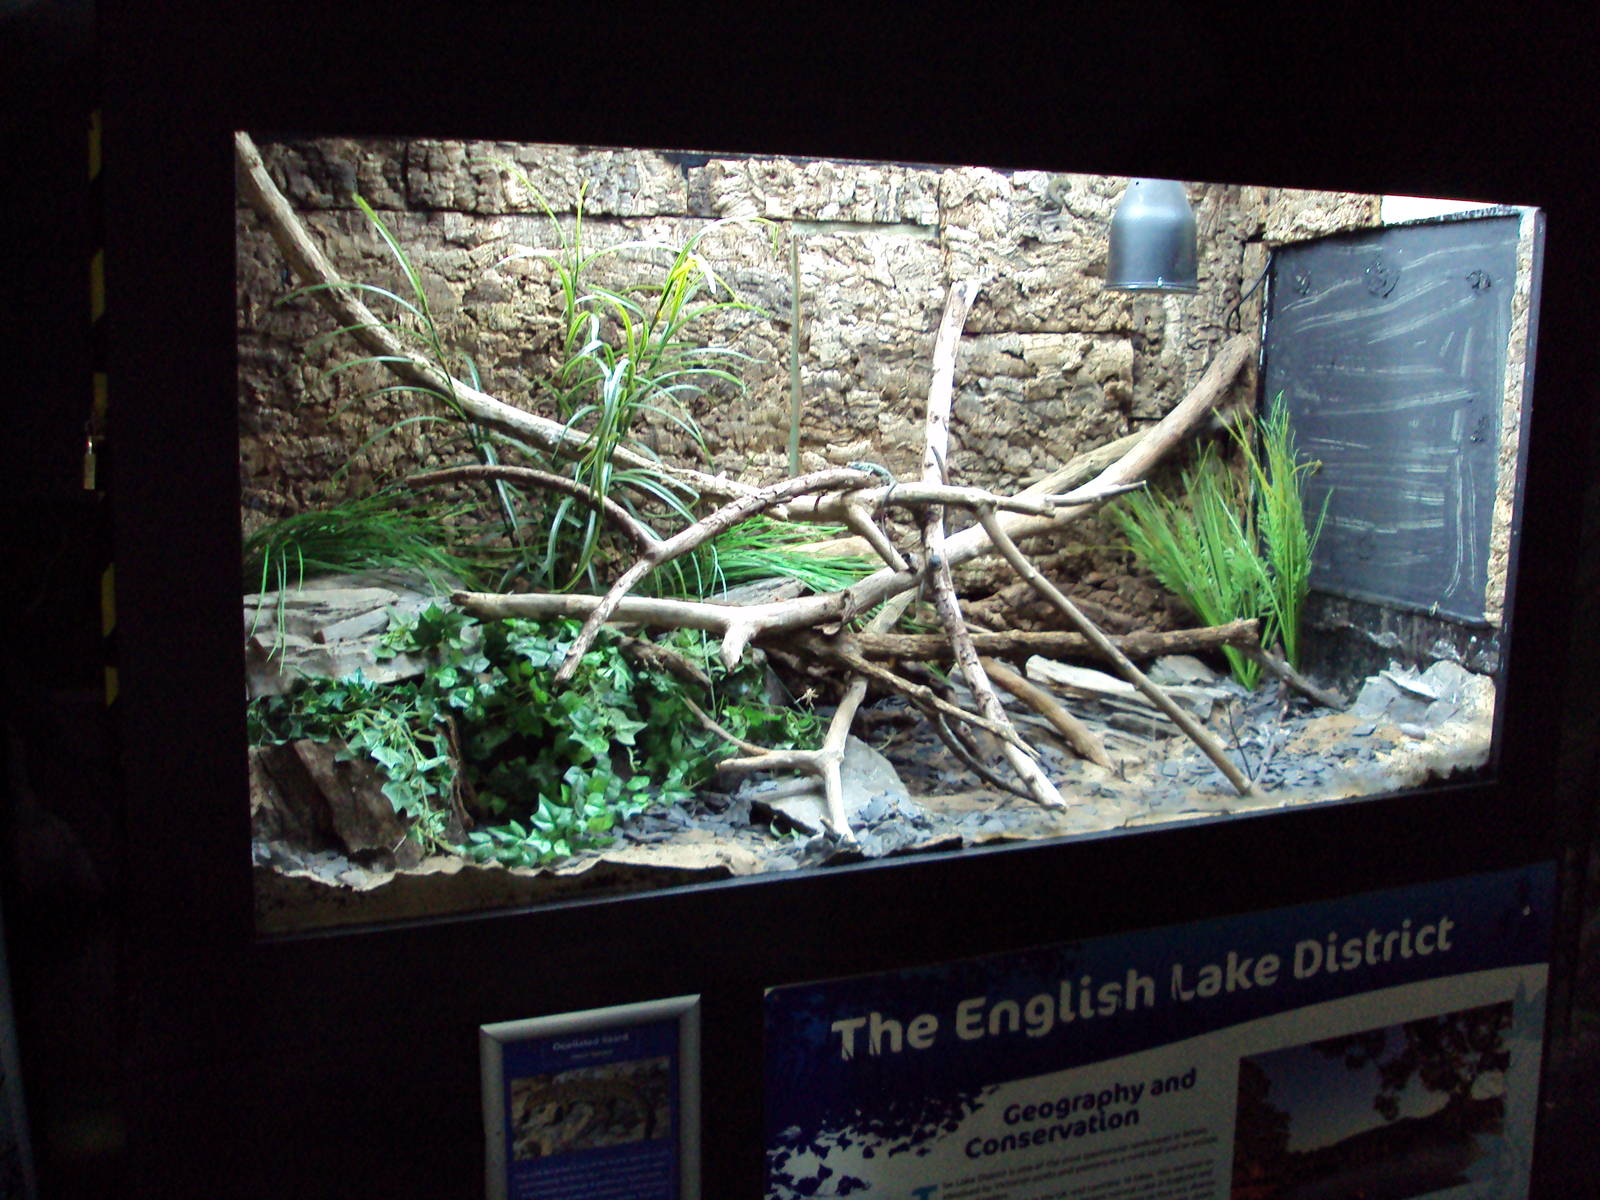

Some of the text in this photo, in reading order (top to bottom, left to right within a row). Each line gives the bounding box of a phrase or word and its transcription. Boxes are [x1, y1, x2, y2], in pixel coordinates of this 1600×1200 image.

[830, 916, 1456, 1062] The English Lake District
[1003, 1067, 1197, 1126] Geography and
[965, 1107, 1140, 1159] Conservation
